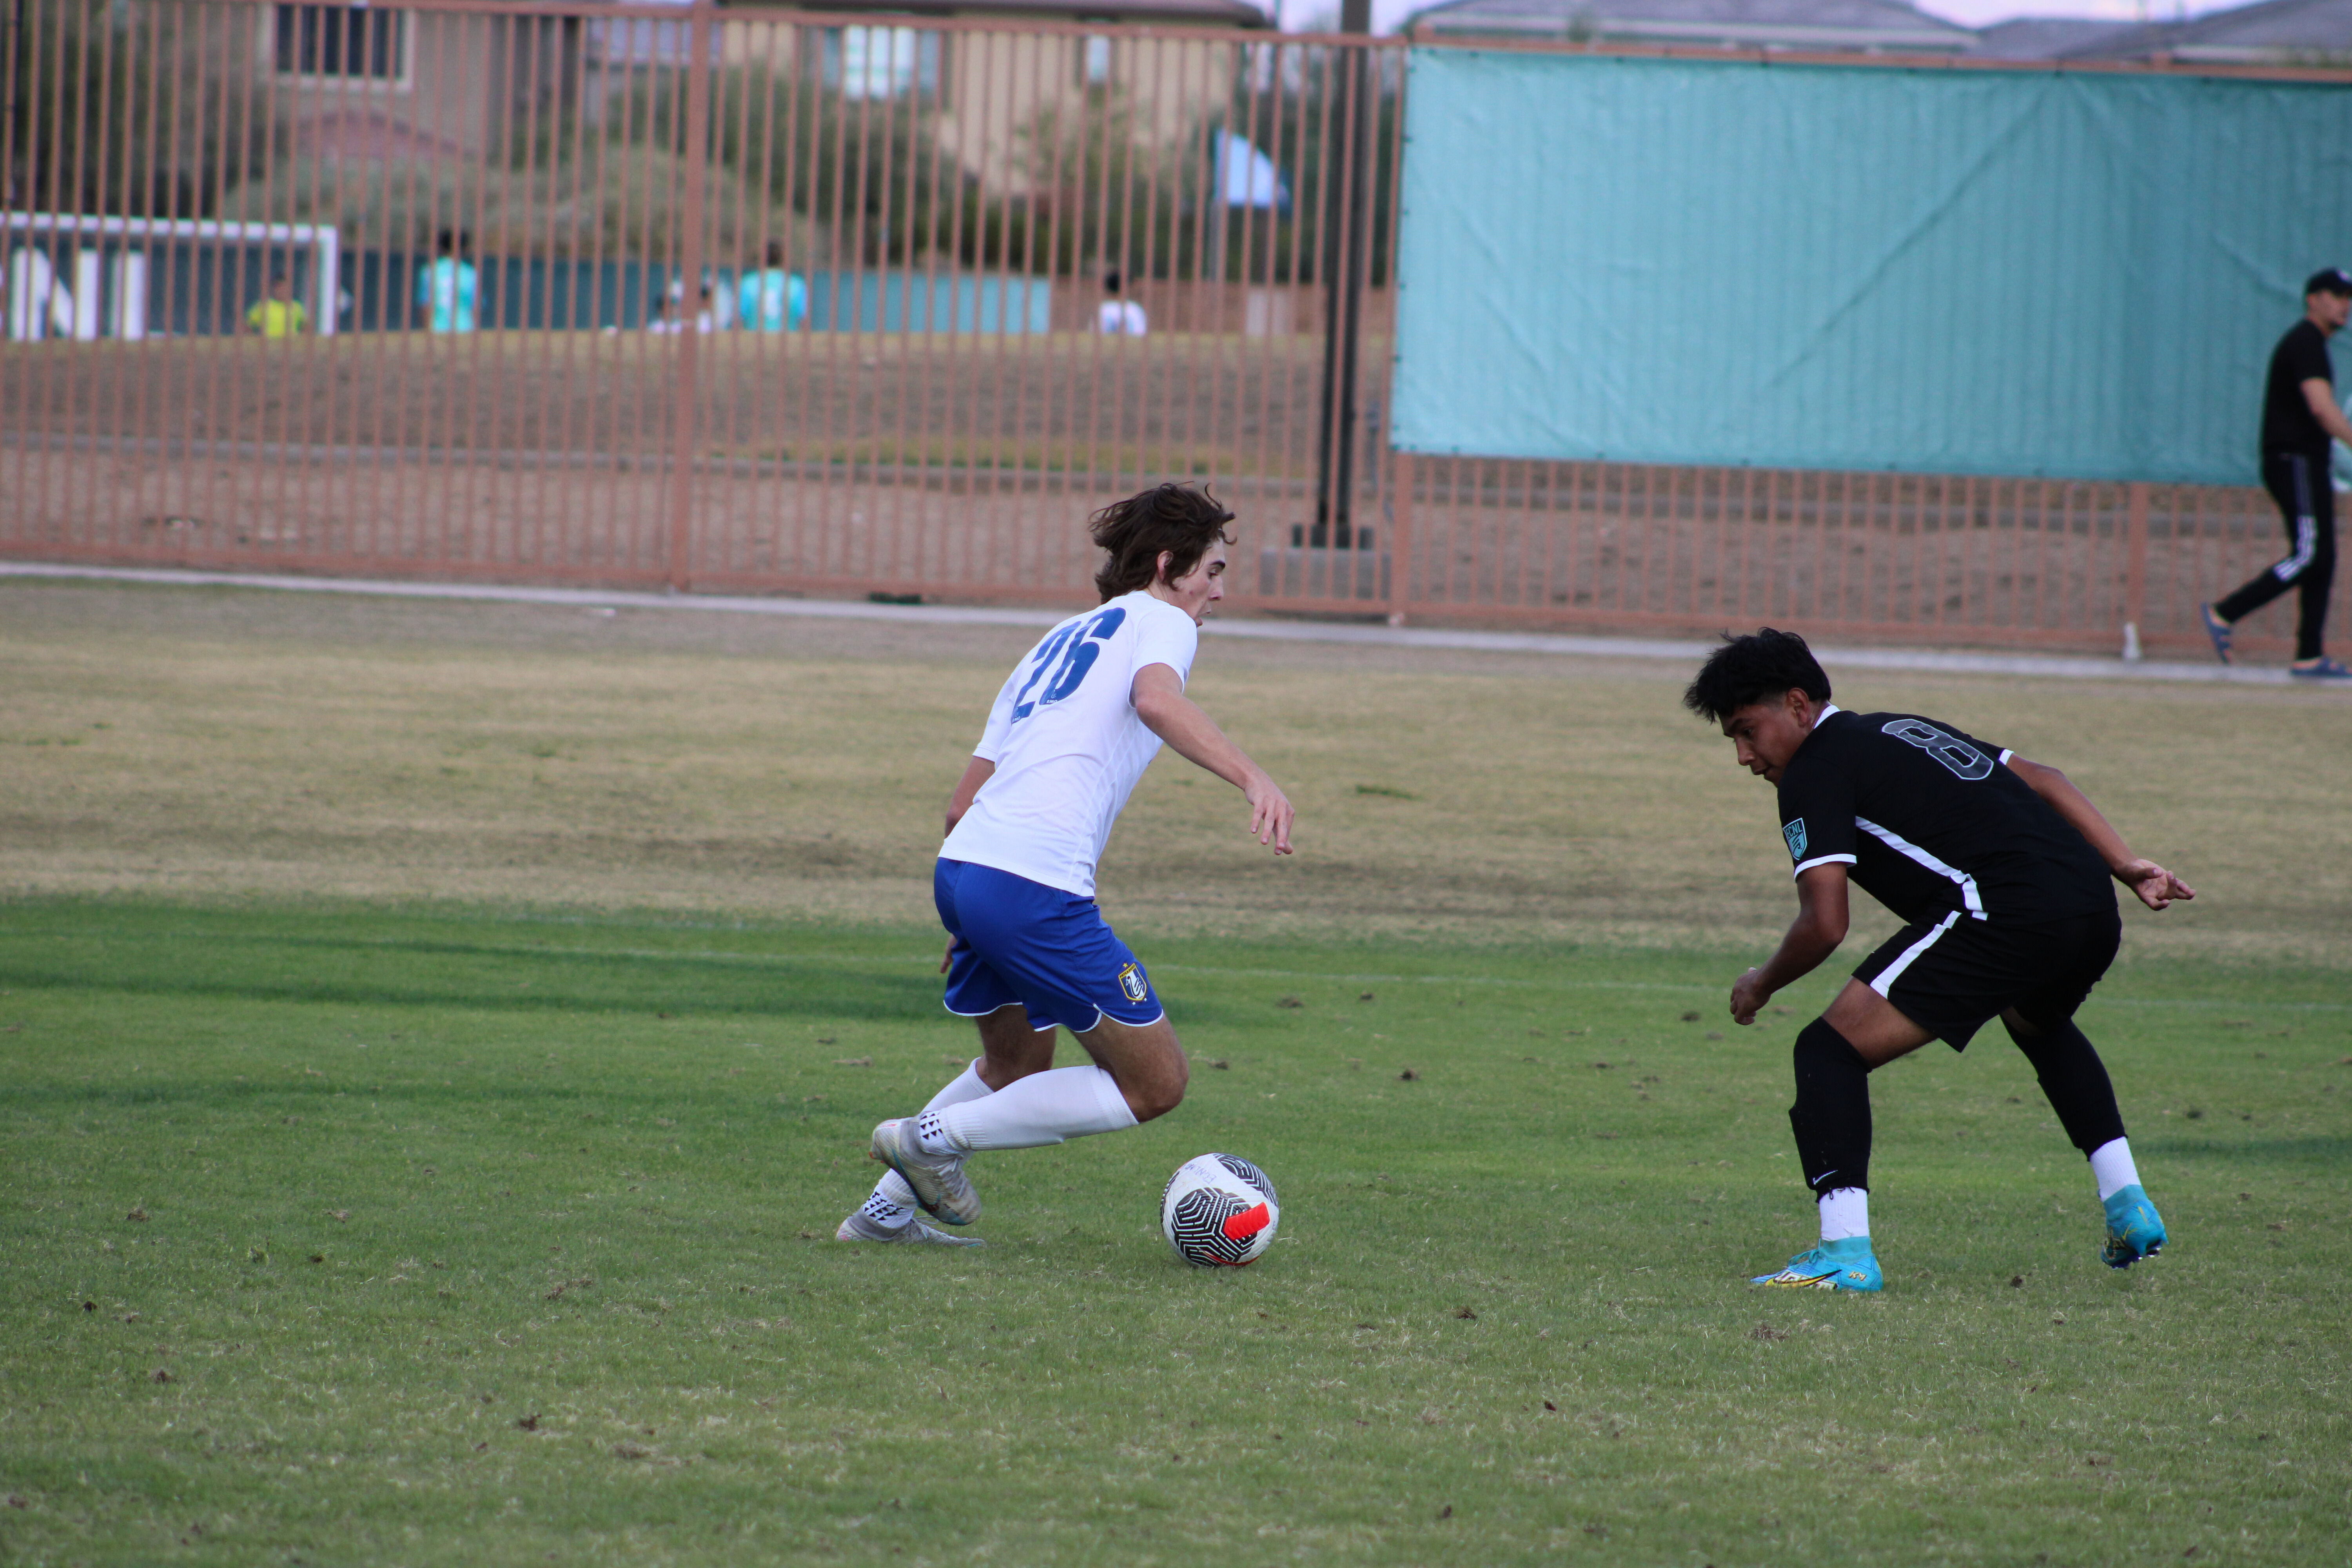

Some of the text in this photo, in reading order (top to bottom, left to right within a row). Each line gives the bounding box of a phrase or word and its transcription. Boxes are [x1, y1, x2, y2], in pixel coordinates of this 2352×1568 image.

[1011, 607, 1126, 724] 26
[1882, 719, 1994, 780] 8
[1785, 822, 1803, 838] ECNL
